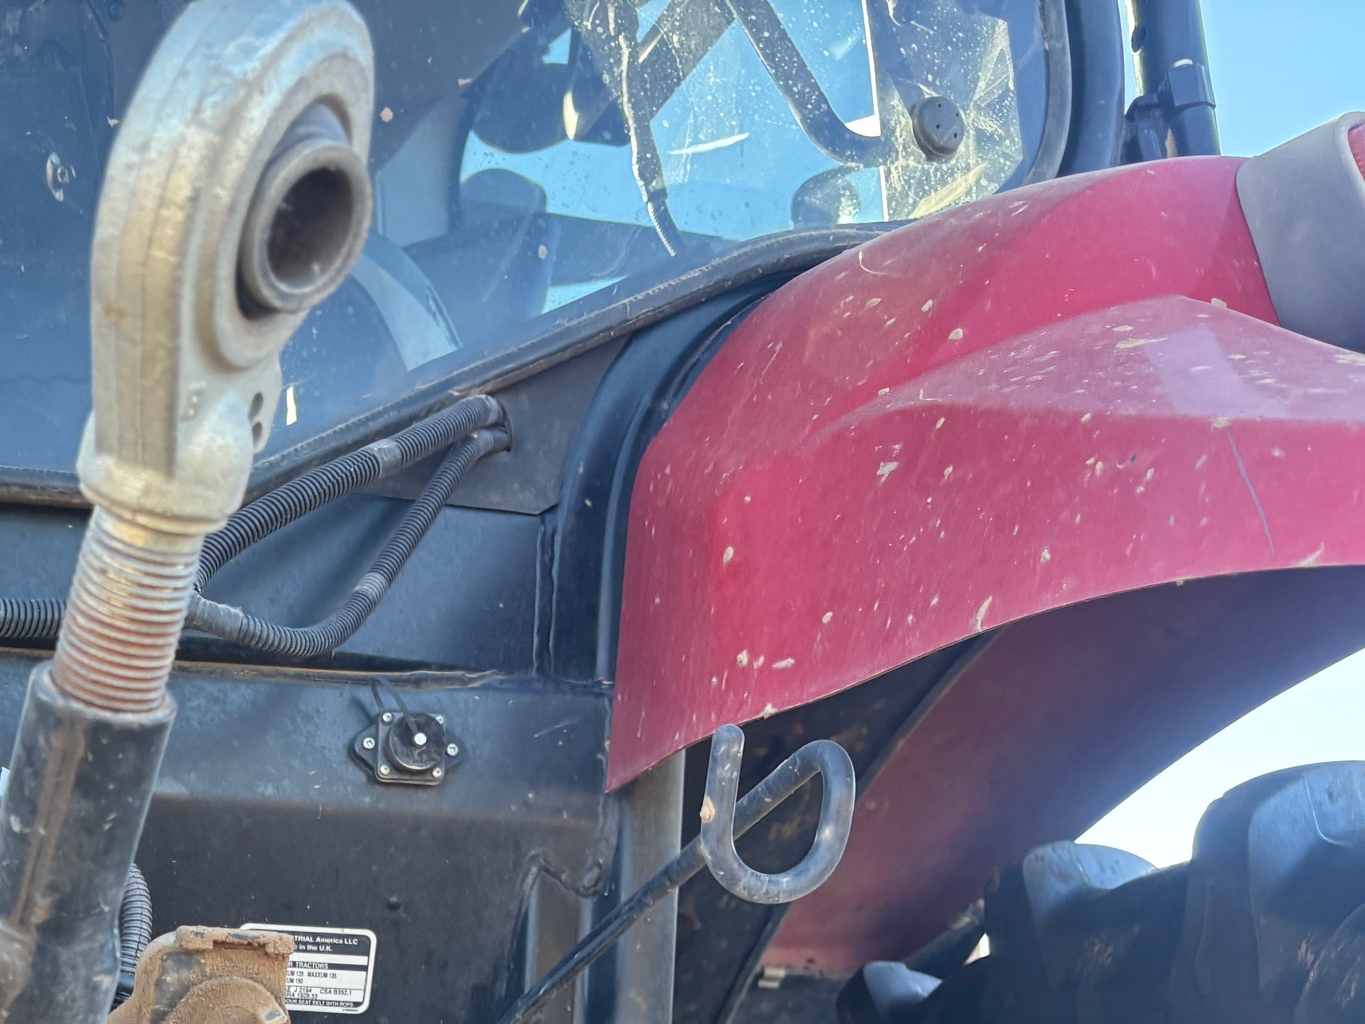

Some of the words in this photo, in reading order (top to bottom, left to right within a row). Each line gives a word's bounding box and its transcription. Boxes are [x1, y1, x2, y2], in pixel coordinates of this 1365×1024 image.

[293, 935, 315, 943] TRIAL
[315, 936, 343, 944] America
[295, 962, 329, 970] TRACTORS
